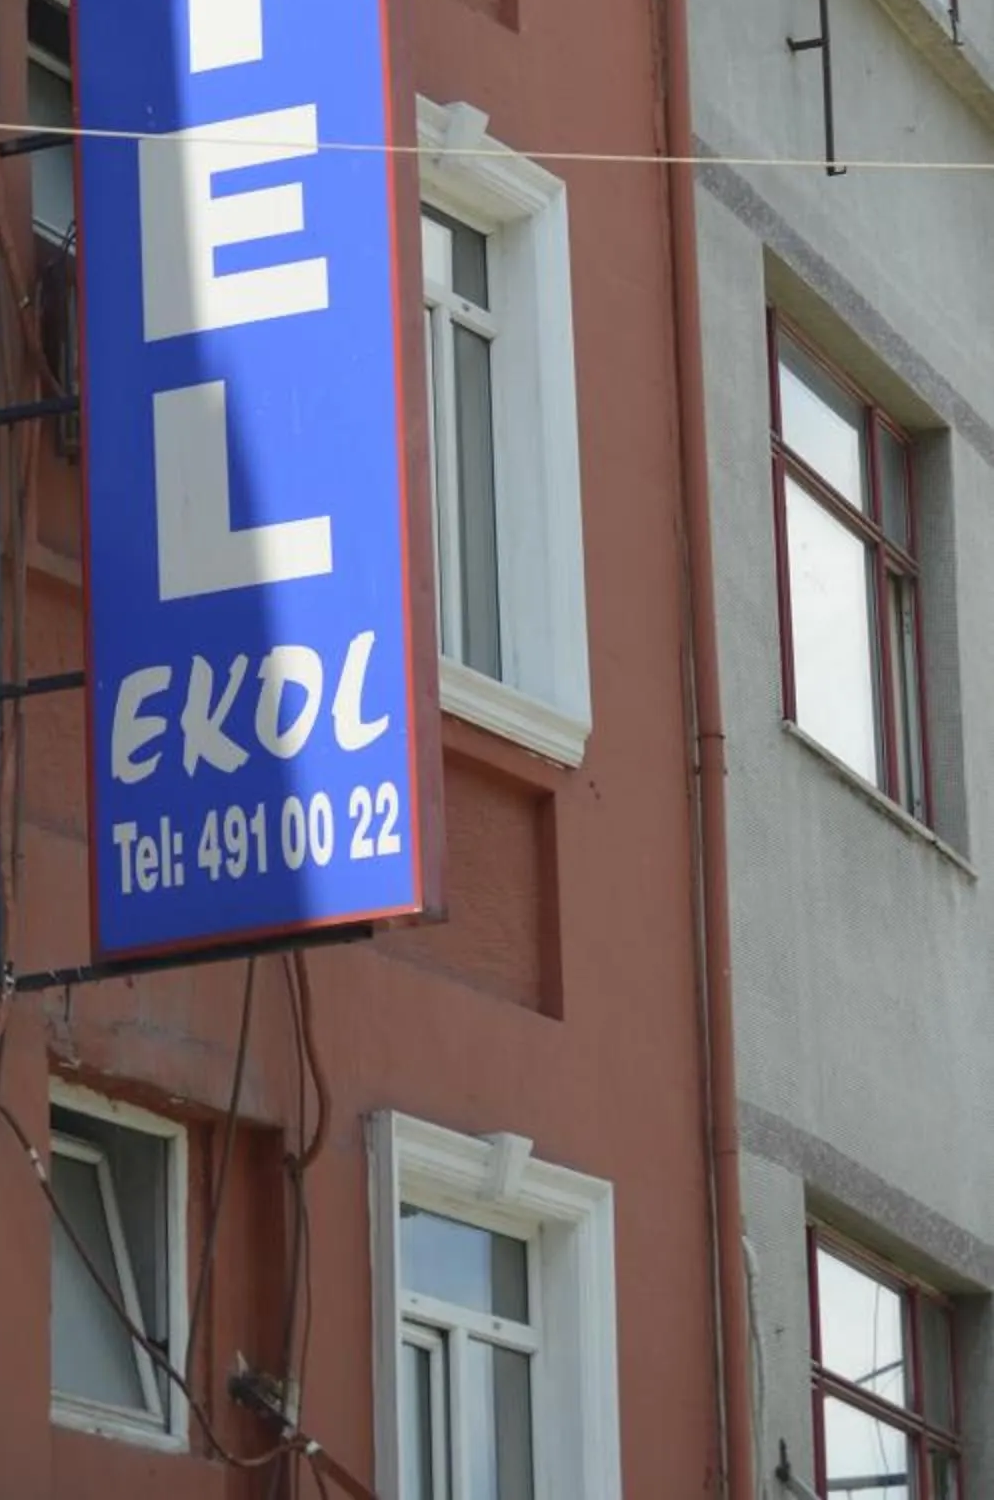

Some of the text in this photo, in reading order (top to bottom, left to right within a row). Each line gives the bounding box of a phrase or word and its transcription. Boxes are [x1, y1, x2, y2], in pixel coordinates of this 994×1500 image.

[111, 630, 390, 784] EKOL
[113, 781, 401, 894] Tel: 491 00 22
